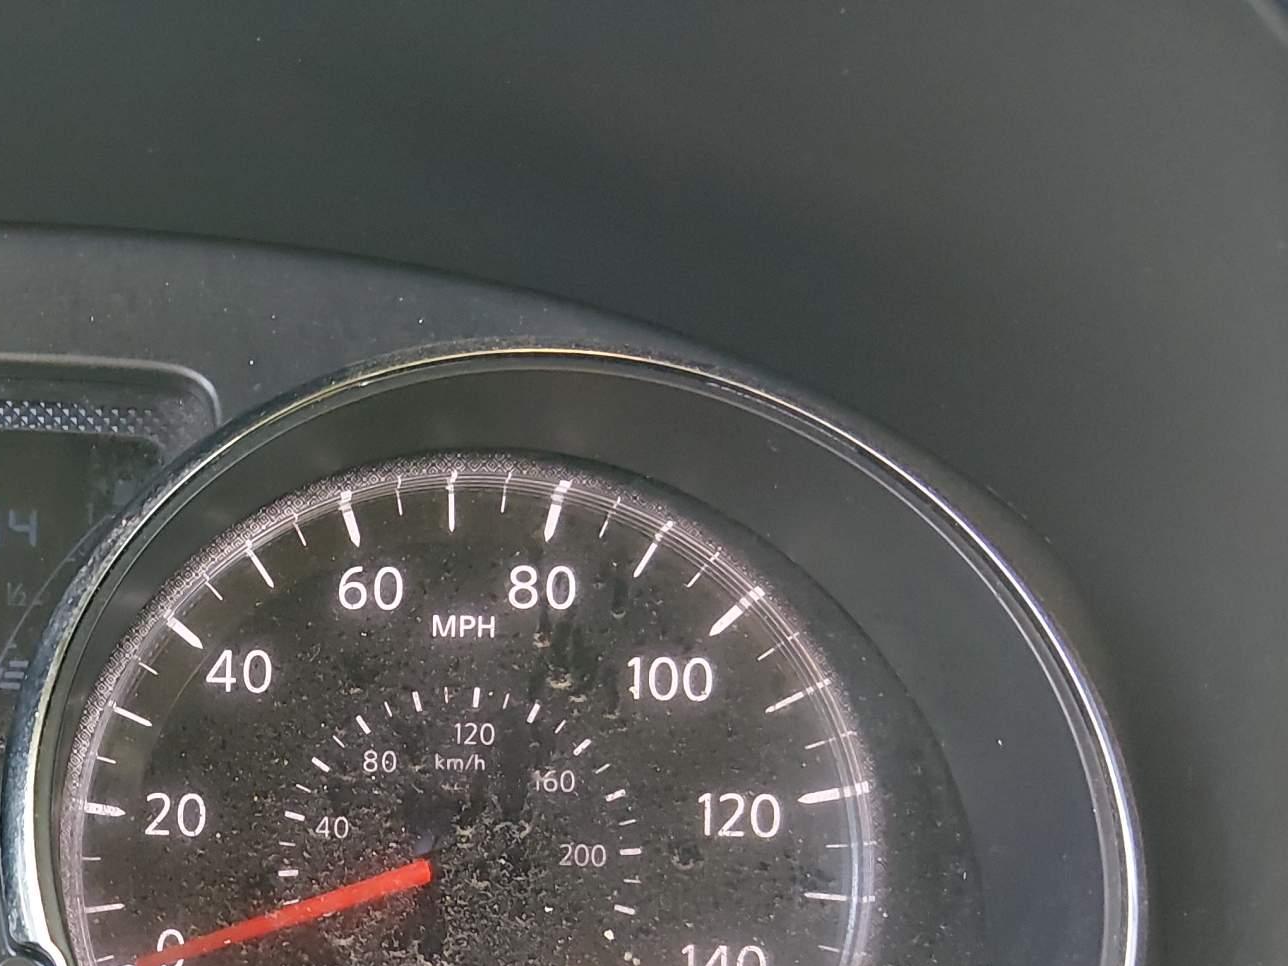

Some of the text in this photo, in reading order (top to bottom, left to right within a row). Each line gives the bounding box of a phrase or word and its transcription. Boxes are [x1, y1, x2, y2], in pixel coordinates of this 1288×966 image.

[337, 566, 404, 611] 60
[508, 565, 576, 610] 80
[431, 615, 496, 638] MPH
[205, 649, 272, 693] 40
[627, 656, 713, 702] 100
[454, 723, 495, 746] 120
[362, 750, 397, 772] 80
[434, 753, 486, 771] km/h
[534, 770, 575, 793] 160
[144, 793, 206, 837] 20
[698, 793, 781, 838] 120
[315, 816, 349, 839] 40
[559, 844, 606, 867] 200
